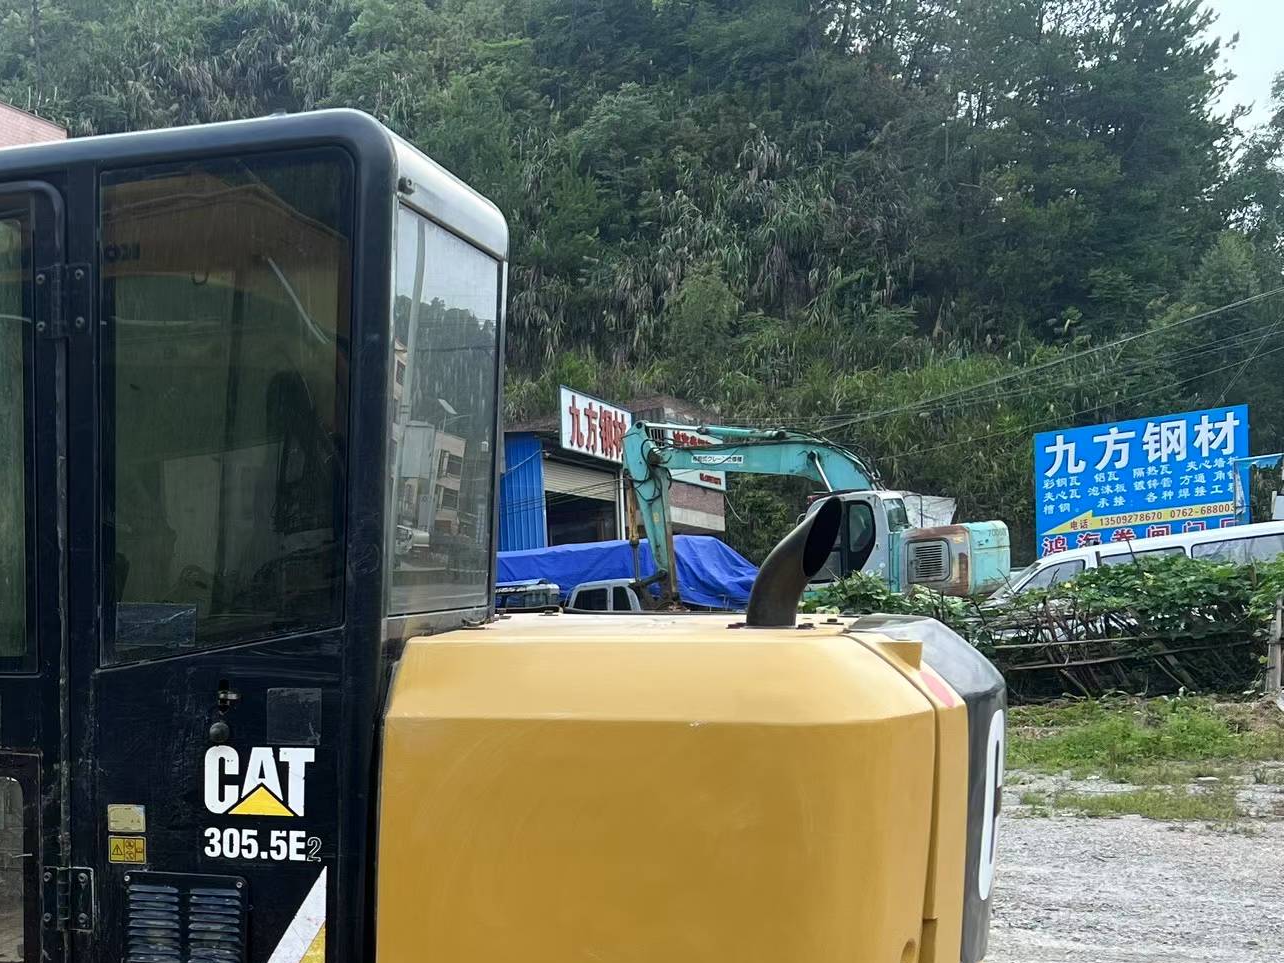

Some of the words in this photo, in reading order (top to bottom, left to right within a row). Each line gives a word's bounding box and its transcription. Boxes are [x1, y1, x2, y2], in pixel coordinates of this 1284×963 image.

[1045, 411, 1240, 477] 九方钢材
[1042, 475, 1081, 489] 彩钢瓦
[1094, 470, 1119, 483] 铝瓦
[1132, 464, 1172, 479] 隔热瓦
[1042, 490, 1081, 503] 夹心瓦
[1134, 477, 1172, 492] 镀锌管
[1179, 472, 1206, 485] 方通
[1100, 511, 1163, 527] 13509278670
[204, 745, 316, 817] CAT
[204, 827, 322, 862] 305.5E2
